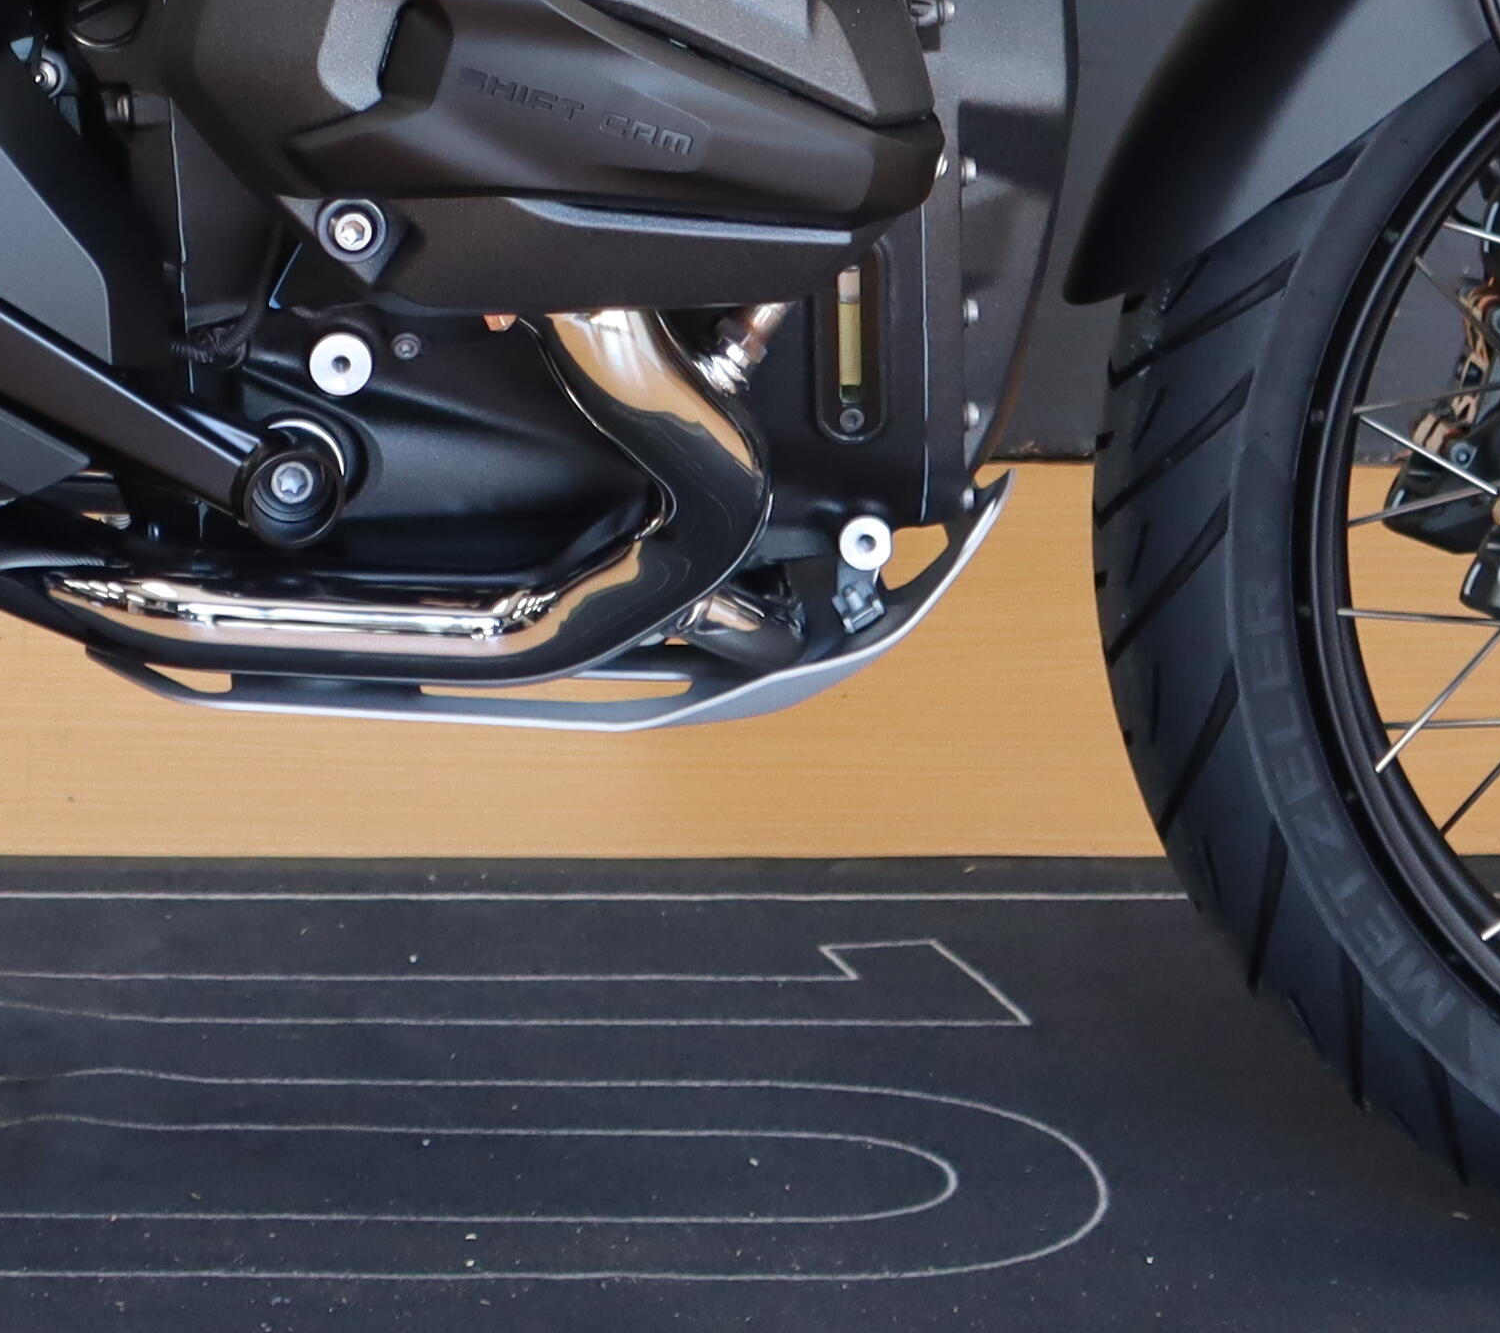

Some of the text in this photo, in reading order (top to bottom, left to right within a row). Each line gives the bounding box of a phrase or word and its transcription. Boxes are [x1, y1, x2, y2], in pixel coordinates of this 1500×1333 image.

[459, 66, 695, 156] SHIFT CAM
[1237, 574, 1463, 1033] METZELER
